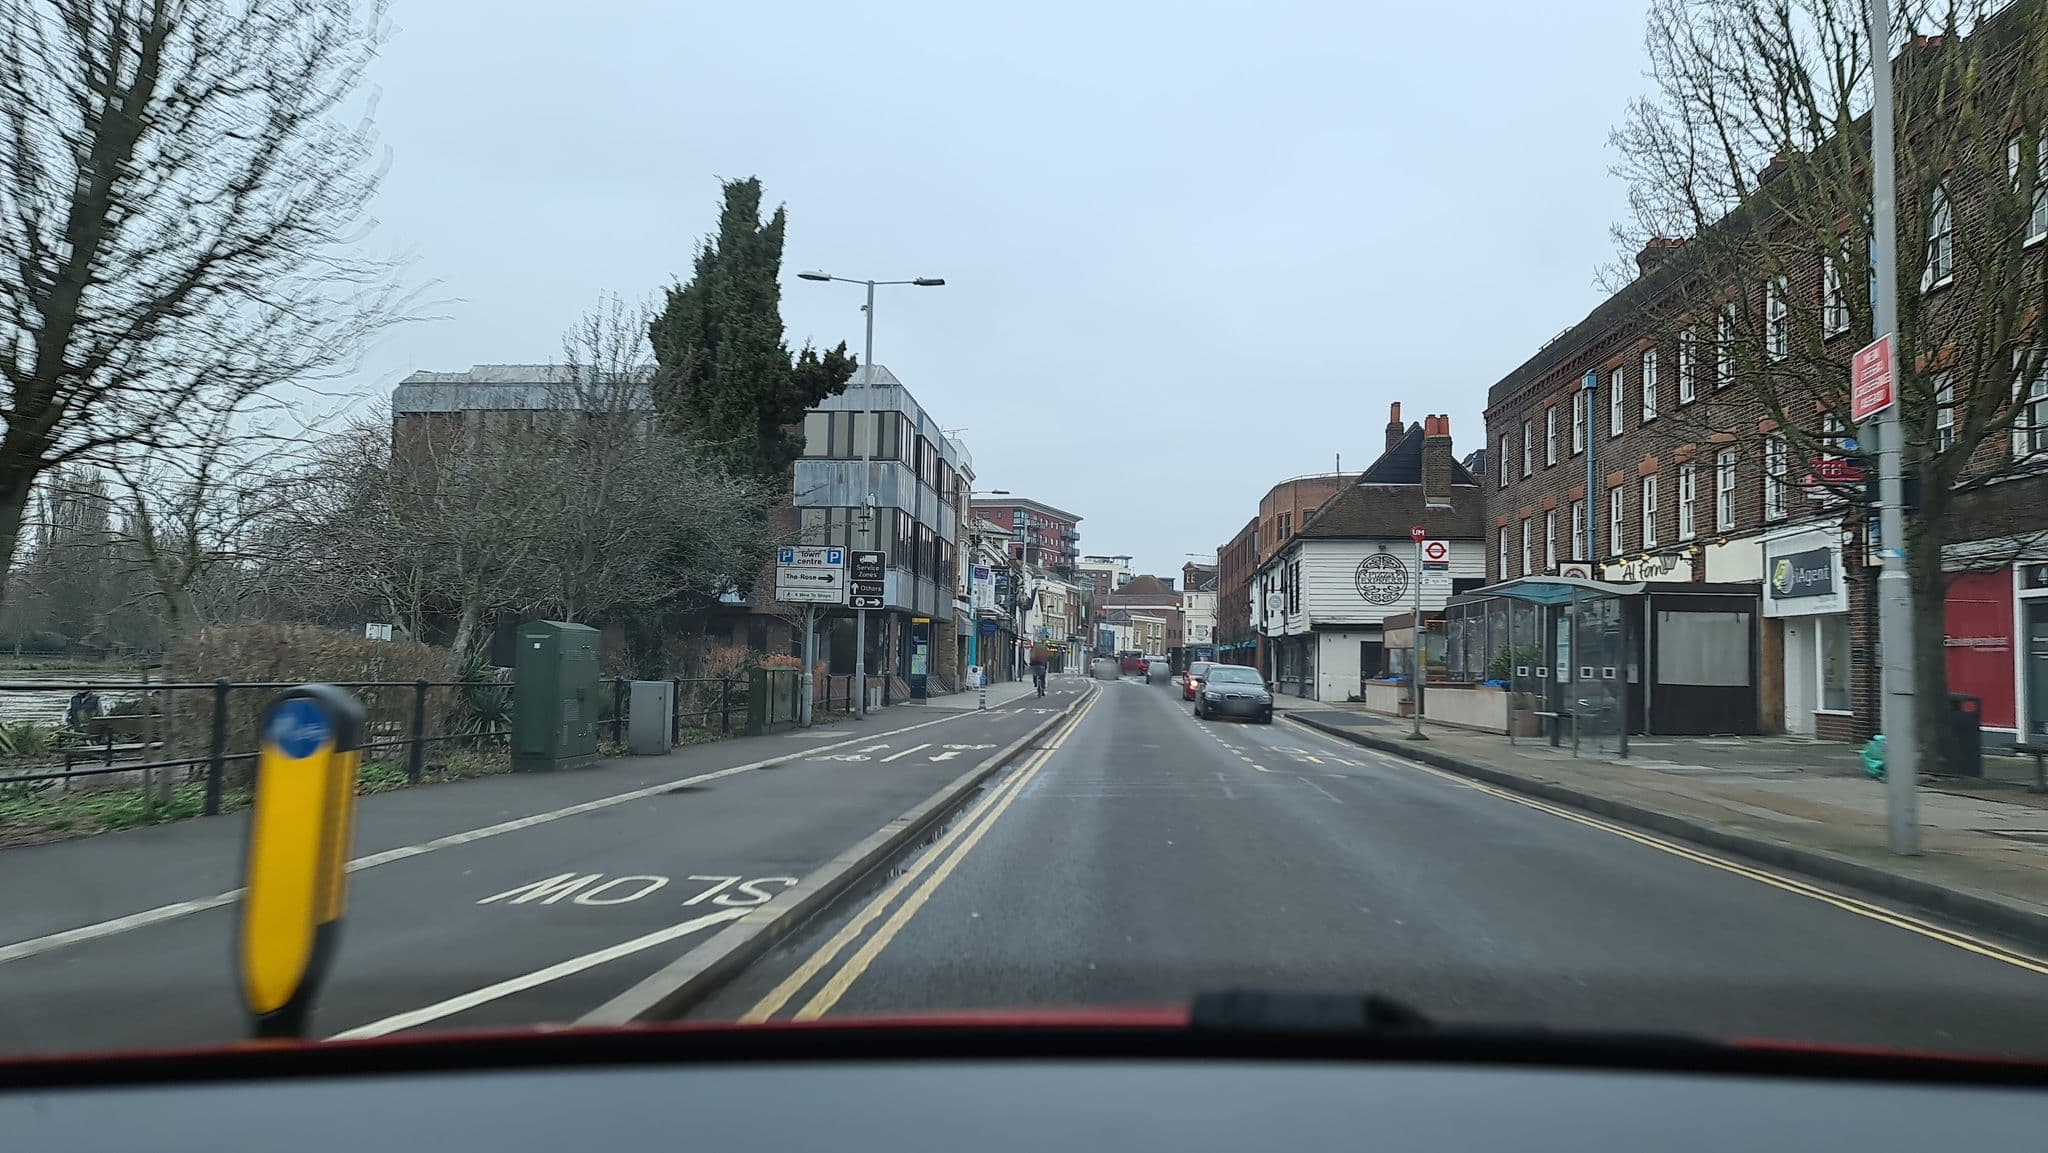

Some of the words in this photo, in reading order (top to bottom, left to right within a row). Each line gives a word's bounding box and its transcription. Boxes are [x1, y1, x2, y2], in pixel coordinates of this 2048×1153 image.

[782, 550, 792, 562] P
[830, 551, 840, 563] P
[1622, 564, 1635, 581] Al
[1795, 564, 1830, 587] iAgent
[1360, 577, 1403, 585] EXPRESS
[475, 872, 799, 906] SLOW
